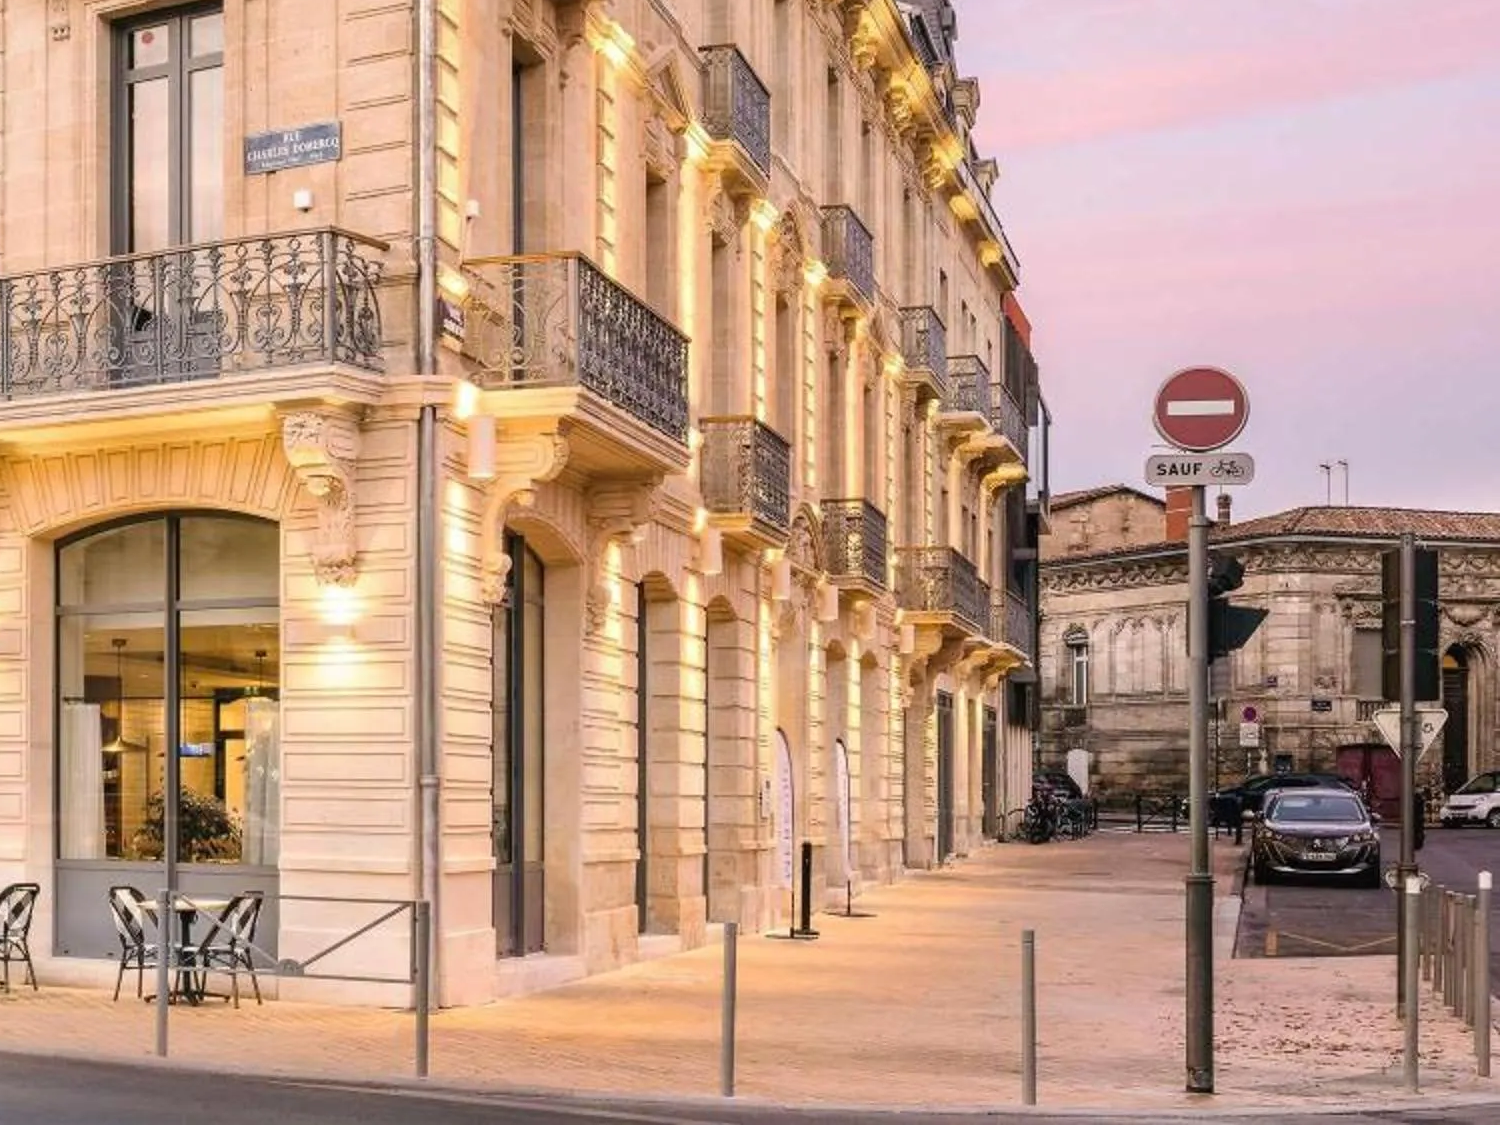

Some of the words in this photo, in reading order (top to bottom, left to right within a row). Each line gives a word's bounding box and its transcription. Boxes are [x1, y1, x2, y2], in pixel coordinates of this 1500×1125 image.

[282, 130, 300, 143] RUE
[247, 146, 290, 162] CHARLES
[293, 137, 339, 154] DOMERCQ
[1156, 462, 1203, 476] SAUF
